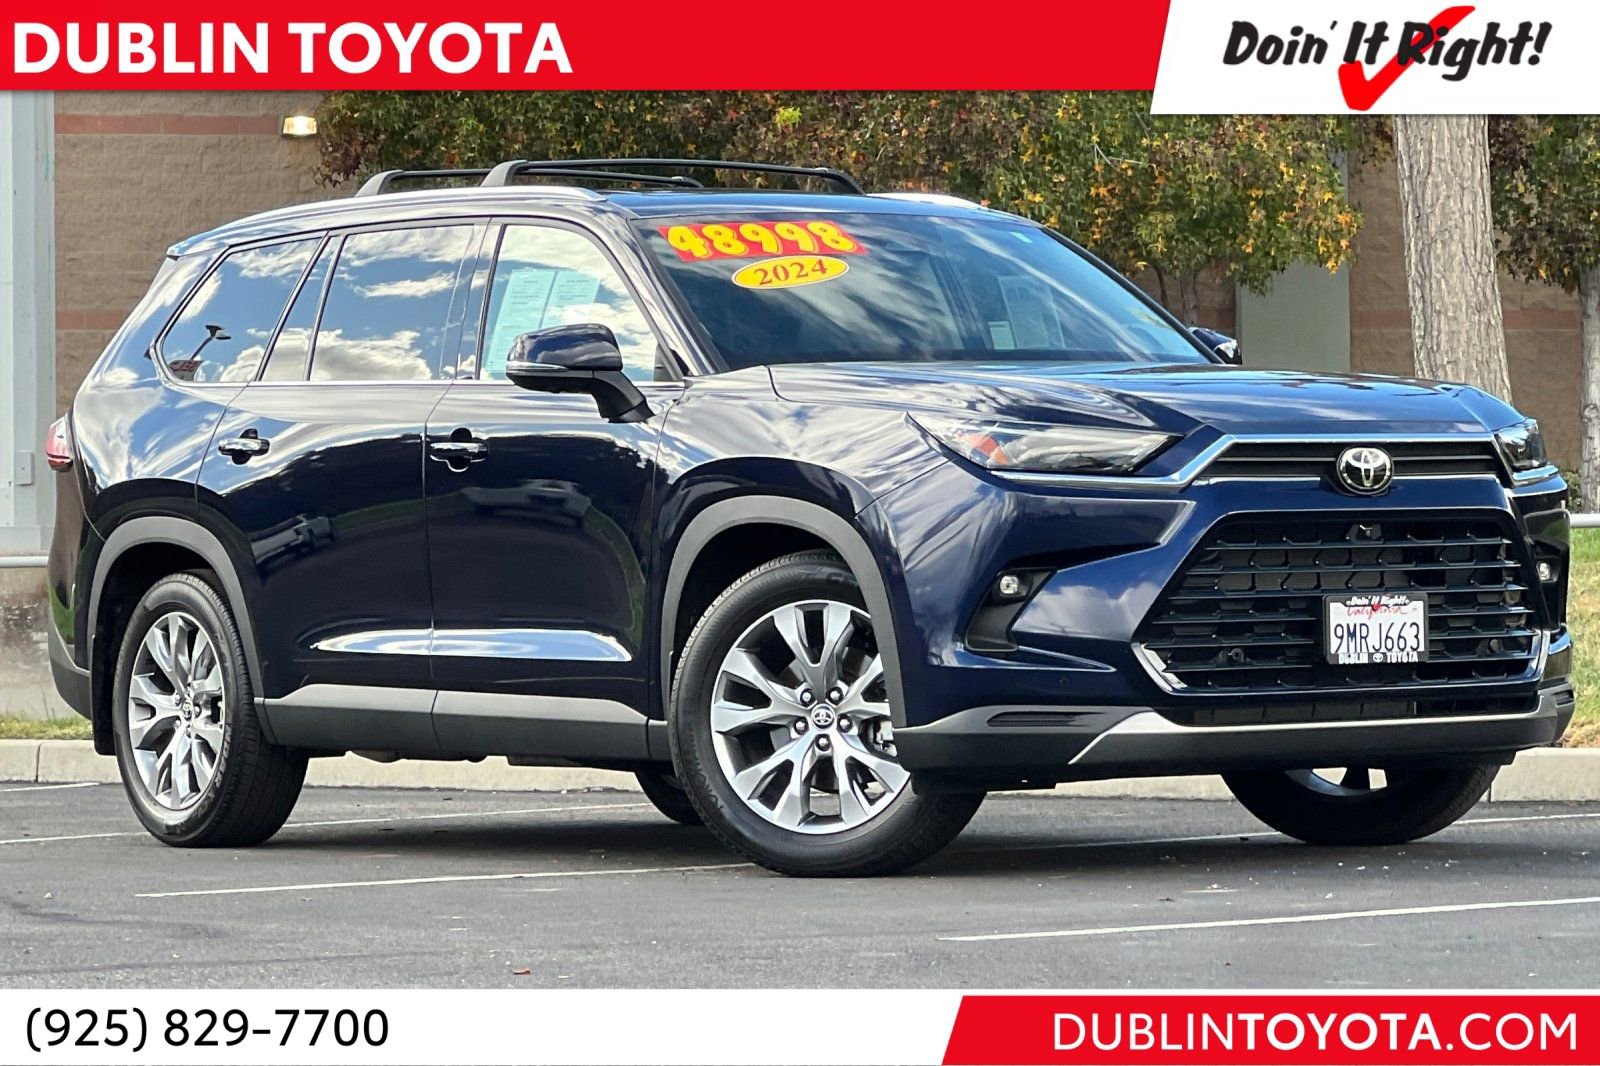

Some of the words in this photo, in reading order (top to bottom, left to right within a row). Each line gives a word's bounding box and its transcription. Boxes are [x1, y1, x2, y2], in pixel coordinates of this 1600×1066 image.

[667, 221, 858, 259] 48998
[753, 258, 828, 286] 2024
[1333, 622, 1420, 654] 9MRJ663
[1338, 652, 1369, 665] DUBLIN
[1386, 650, 1419, 663] TOYOTA
